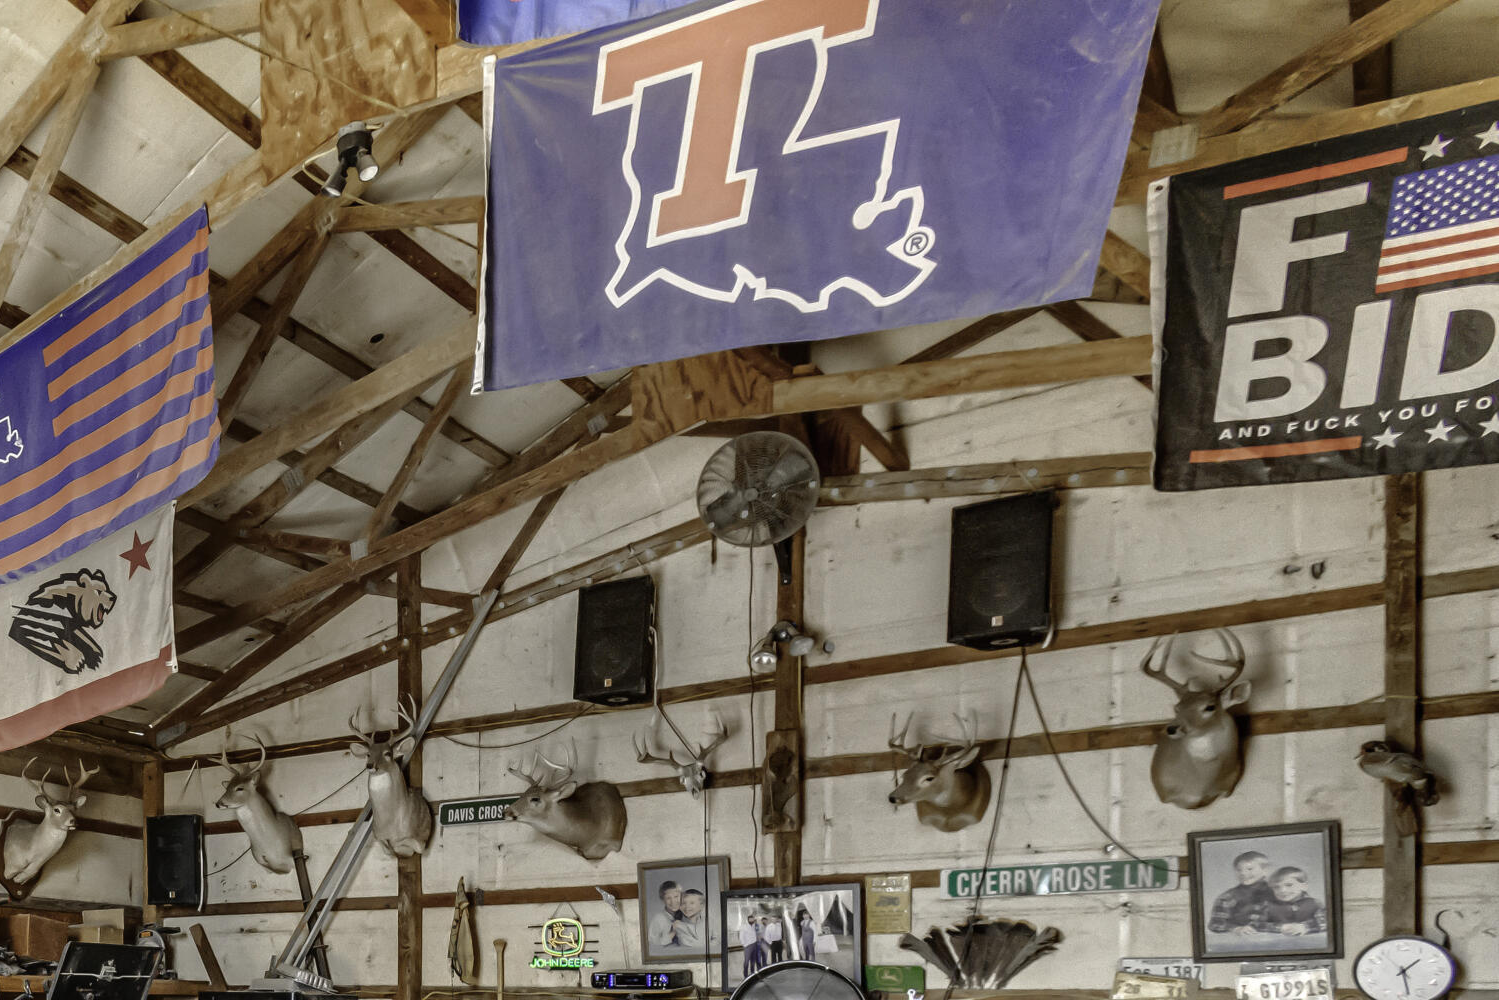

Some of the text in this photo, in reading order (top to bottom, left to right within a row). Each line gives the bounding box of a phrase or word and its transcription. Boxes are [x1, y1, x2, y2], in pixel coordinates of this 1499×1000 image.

[1218, 424, 1271, 441] AND
[1286, 413, 1361, 433] FUCK
[1378, 403, 1437, 424] YOU
[448, 807, 475, 822] DAVIS
[956, 868, 1042, 897] CHERRY
[1051, 865, 1112, 892] ROSE
[529, 957, 594, 969] JOHN DEERE
